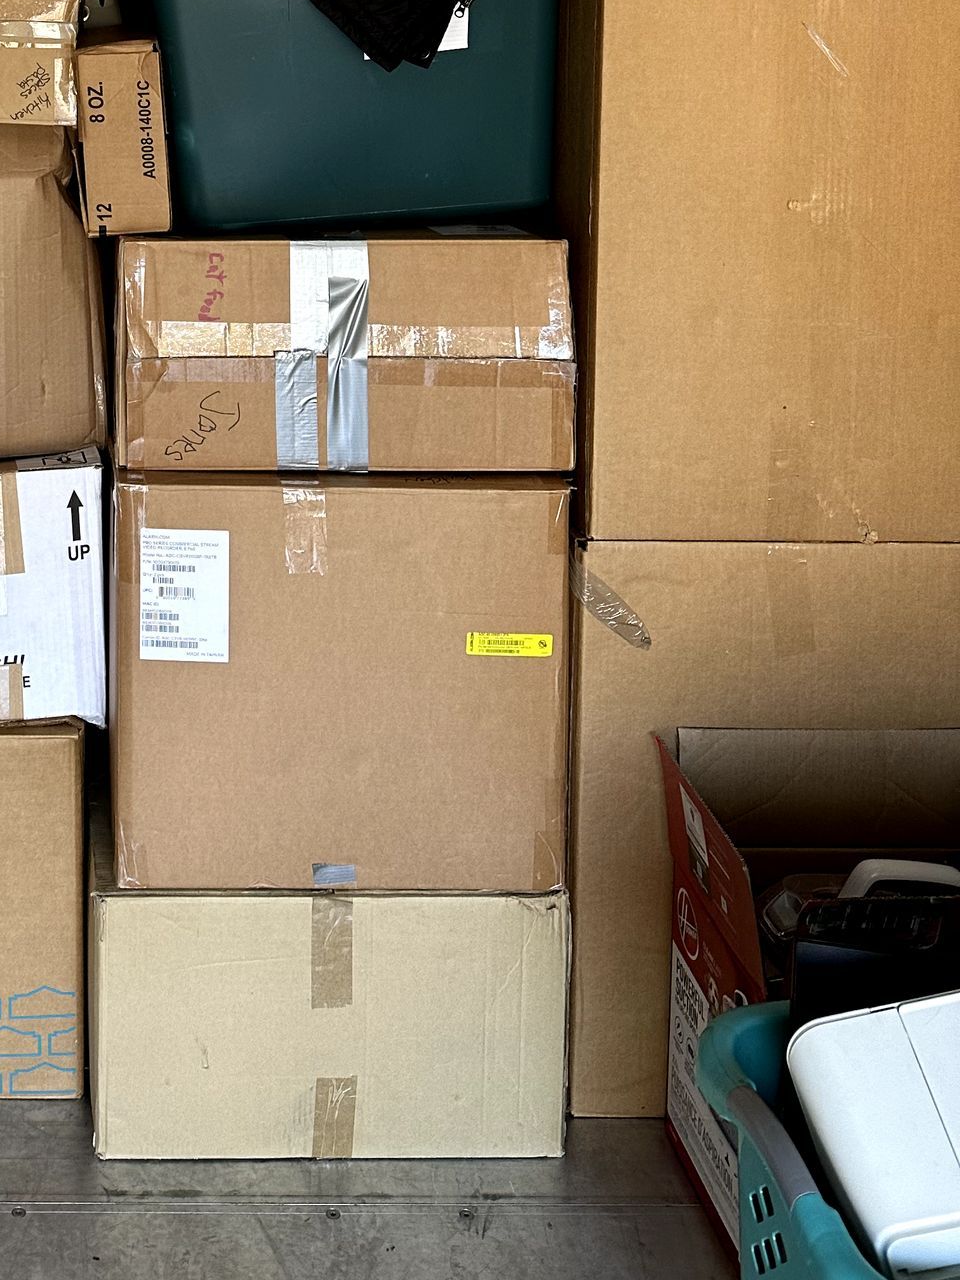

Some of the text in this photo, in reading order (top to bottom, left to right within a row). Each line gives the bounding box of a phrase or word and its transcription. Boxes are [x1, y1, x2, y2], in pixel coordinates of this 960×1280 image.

[87, 81, 106, 123] 8 OZ.
[136, 79, 157, 180] A0008-140C1C
[96, 203, 112, 221] 12
[67, 544, 91, 561] UP
